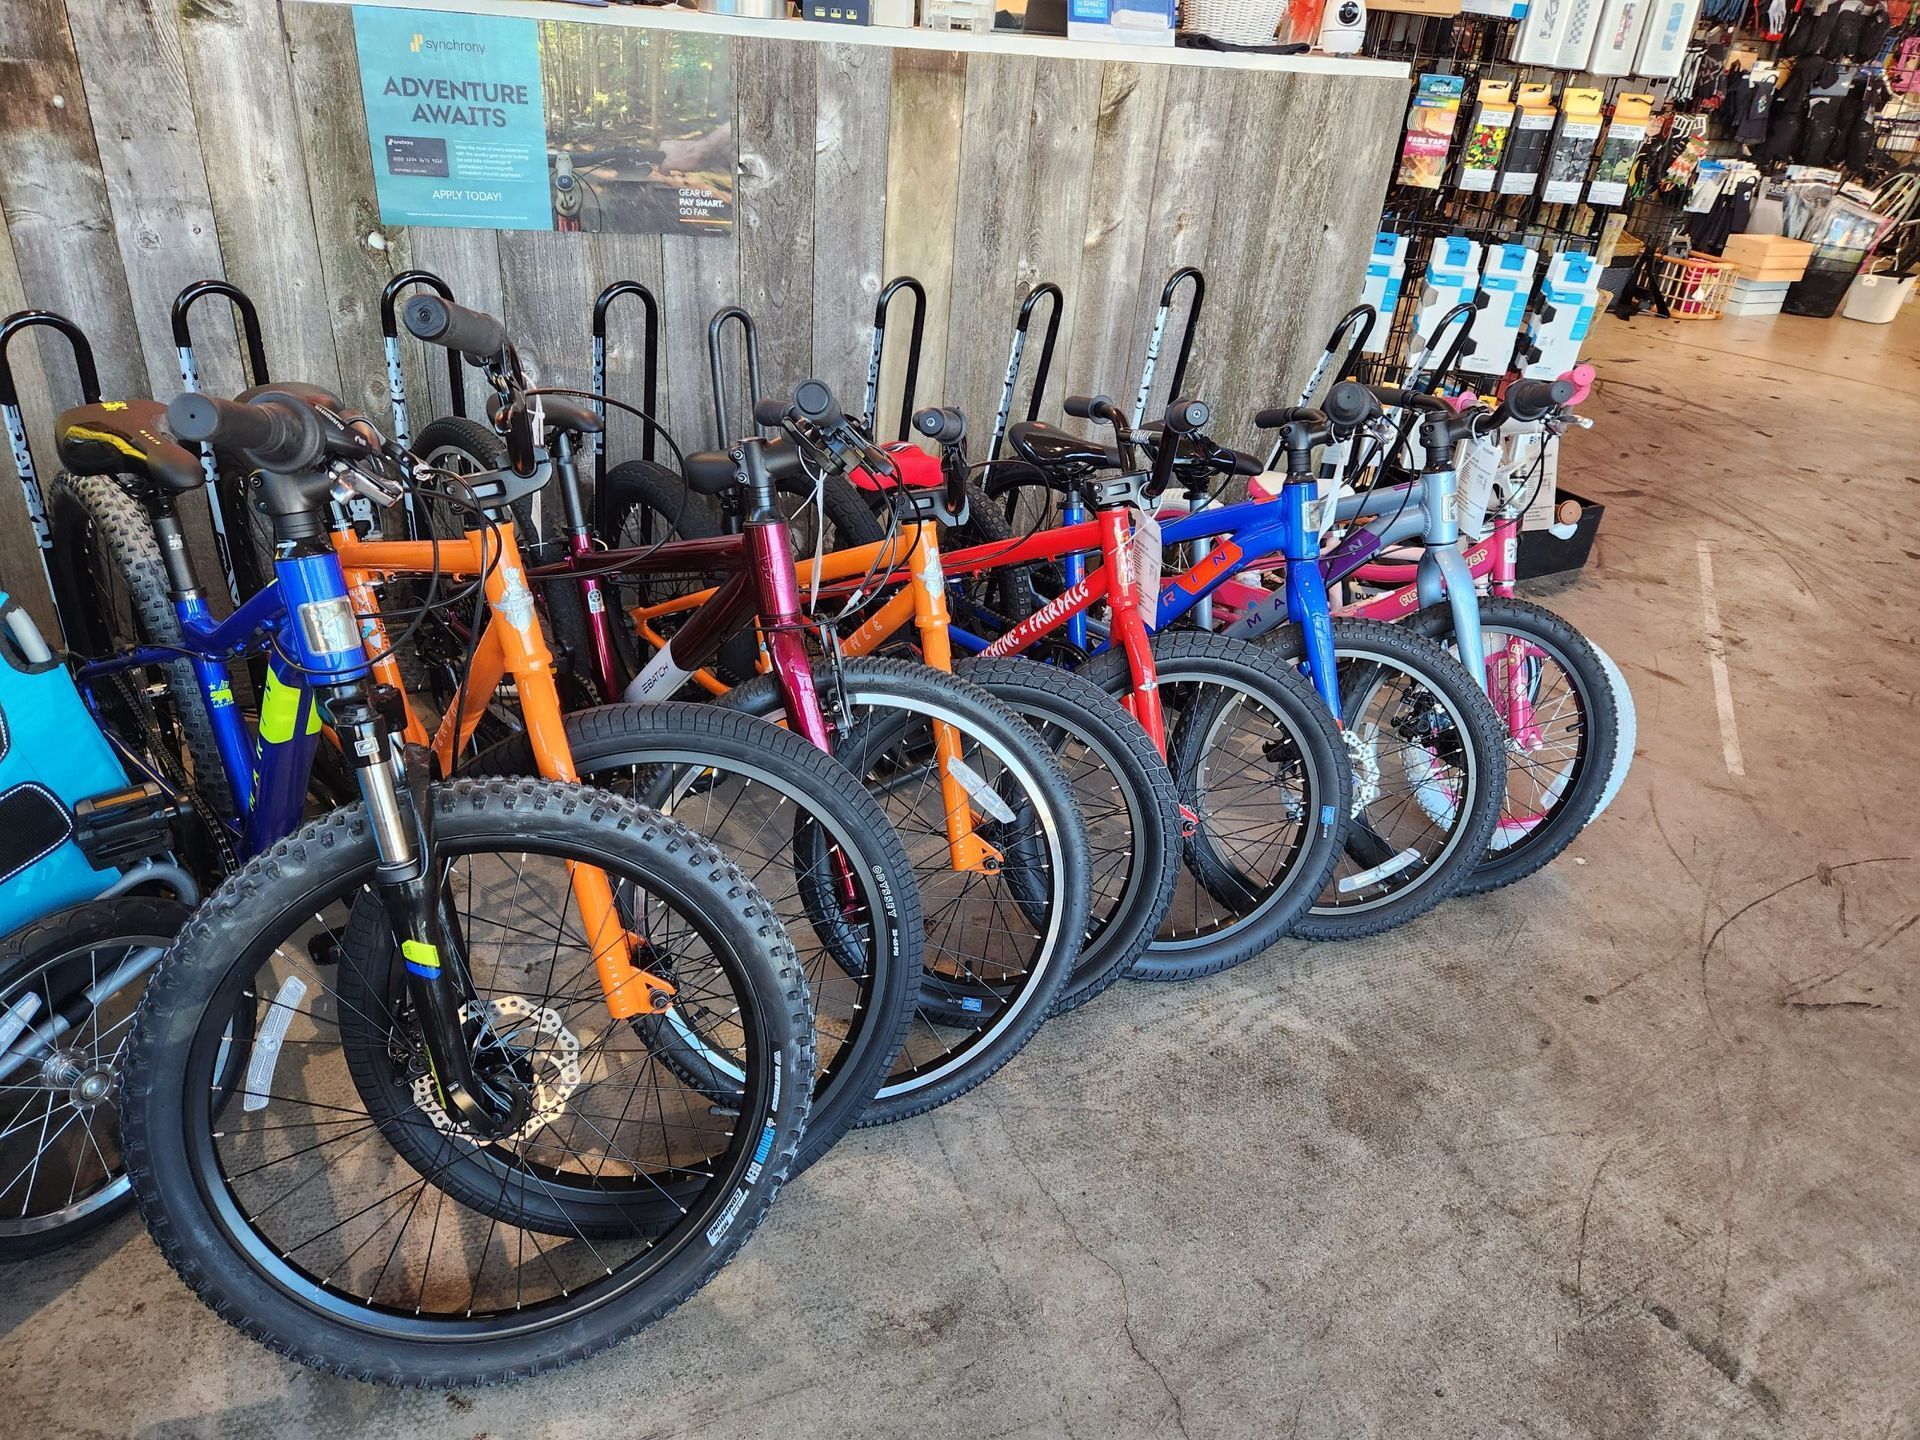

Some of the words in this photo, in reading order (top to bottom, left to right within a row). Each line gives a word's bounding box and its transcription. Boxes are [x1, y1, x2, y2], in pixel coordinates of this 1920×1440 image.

[425, 38, 485, 55] synchrony
[383, 76, 528, 105] ADVENTURE
[412, 103, 507, 128] AWAITS
[432, 190, 462, 200] APPLY
[465, 190, 502, 201] TODAY!
[678, 188, 700, 196] GEAR
[679, 197, 695, 206] PAY
[695, 199, 725, 208] SMART.
[679, 207, 693, 215] GO
[693, 208, 710, 217] FAR.
[1162, 550, 1227, 607] RIN
[1246, 539, 1364, 629] MAIN
[872, 865, 898, 918] ODYSSEY
[754, 1127, 776, 1165] CROWN
[744, 1161, 763, 1185] GEM
[707, 1191, 742, 1238] COMPOUND
[714, 1220, 730, 1242] MPC
